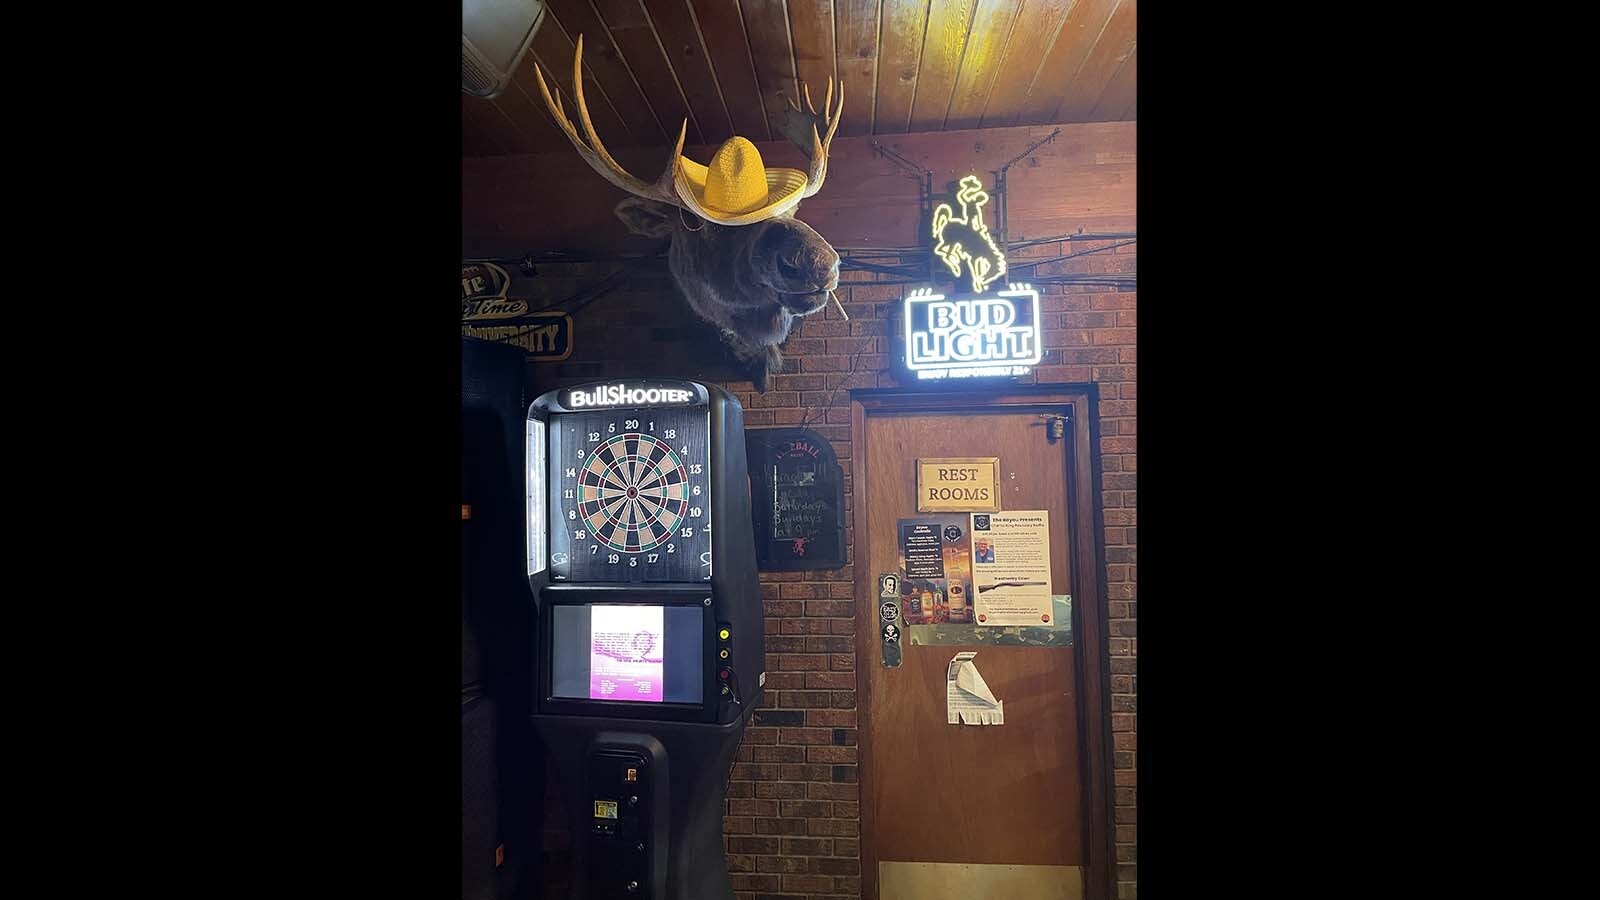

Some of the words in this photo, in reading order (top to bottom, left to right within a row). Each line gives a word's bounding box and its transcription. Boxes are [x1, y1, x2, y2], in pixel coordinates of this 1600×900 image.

[472, 299, 521, 315] Time
[929, 300, 1014, 332] BUD
[913, 328, 1033, 361] LIGHT
[608, 423, 616, 433] 5
[625, 420, 639, 430] 20
[648, 422, 655, 431] 1
[588, 432, 601, 442] 12
[664, 429, 676, 439] 18
[577, 449, 585, 459] 9
[680, 446, 689, 456] 4
[566, 468, 577, 477] 14
[690, 464, 702, 474] 13
[938, 469, 979, 481] REST
[564, 490, 574, 498] 11
[692, 486, 701, 496] 6
[928, 487, 989, 501] ROOMS
[569, 511, 577, 520] 8
[689, 508, 702, 517] 10
[574, 529, 586, 540] 16
[681, 528, 692, 538] 15
[590, 545, 598, 554] 7
[667, 544, 675, 553] 2
[608, 554, 619, 564] 19
[629, 557, 637, 567] 3
[647, 553, 659, 563] 17
